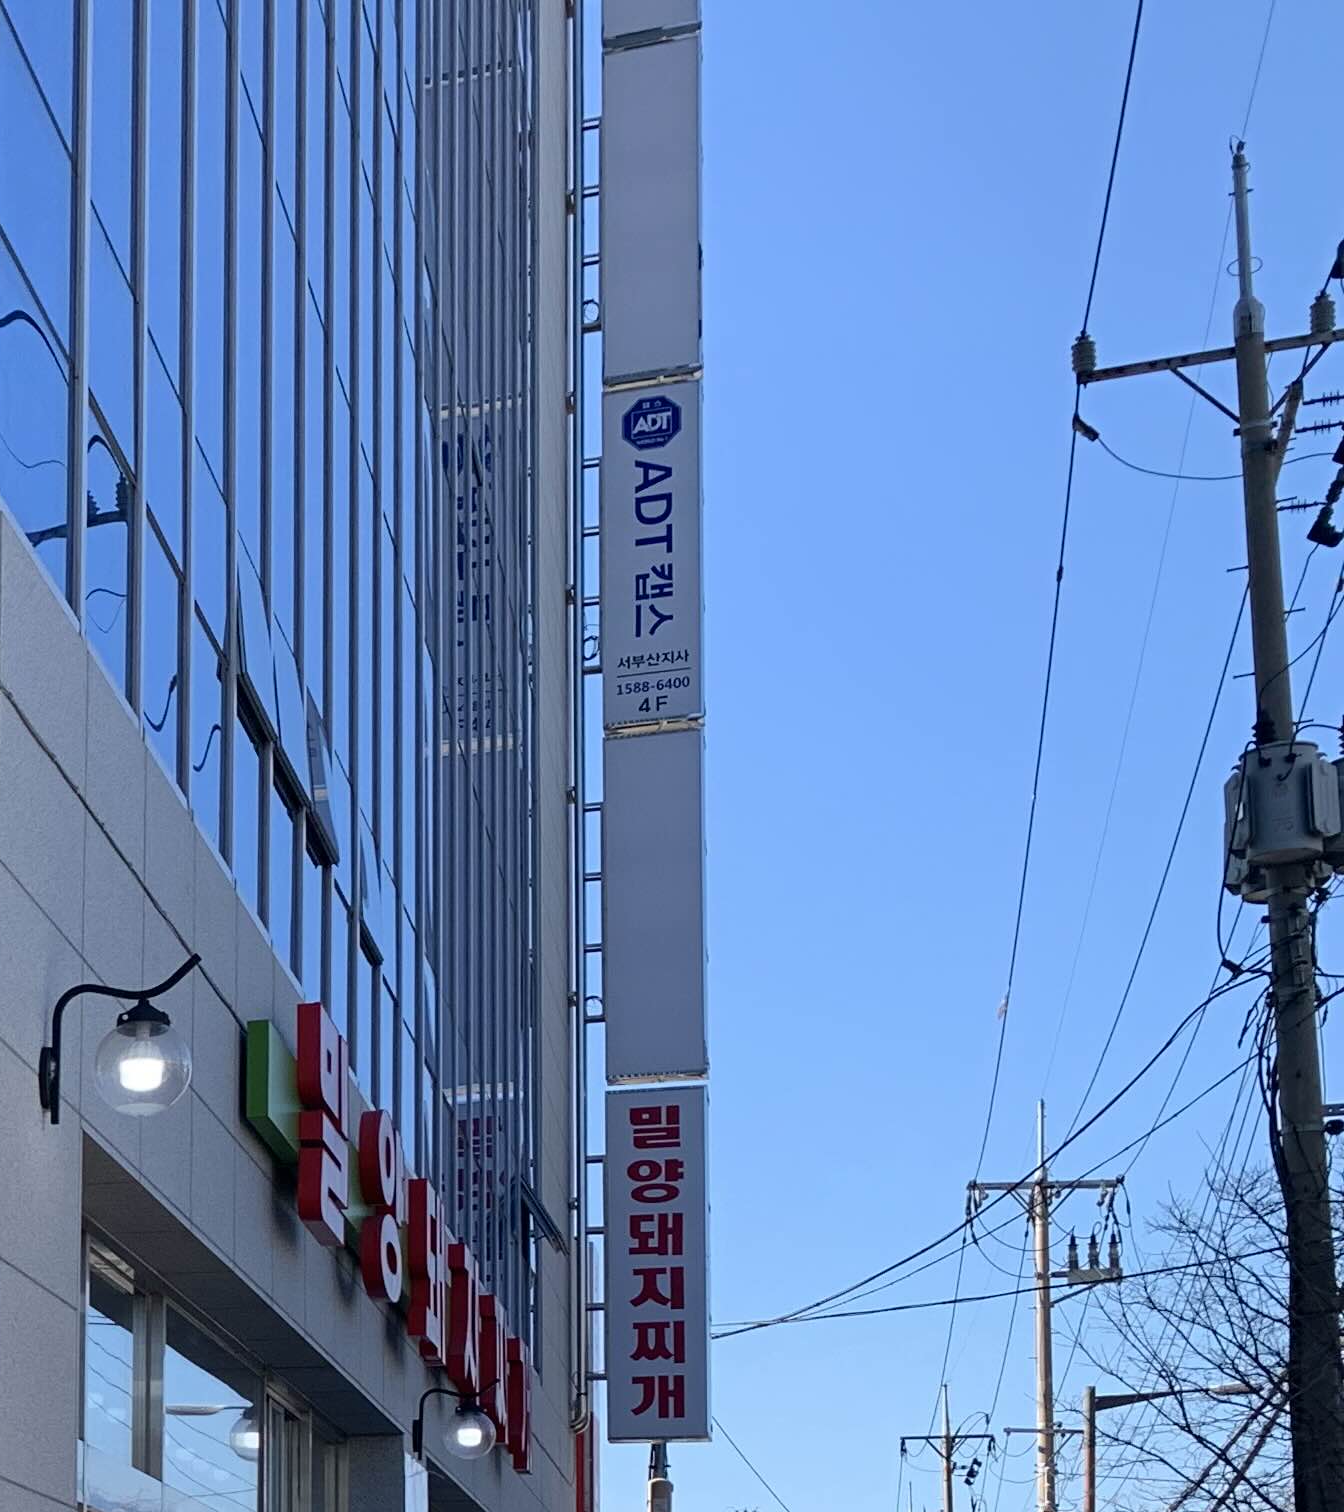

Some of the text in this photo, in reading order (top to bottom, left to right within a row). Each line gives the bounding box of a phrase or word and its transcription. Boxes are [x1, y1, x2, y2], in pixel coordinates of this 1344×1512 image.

[632, 411, 672, 434] ADT
[634, 460, 673, 553] ADT
[634, 562, 674, 637] 캡스
[617, 649, 689, 669] 서부산지사
[616, 676, 690, 695] 1588-6400
[626, 1104, 687, 1420] 밀양돼지찌개
